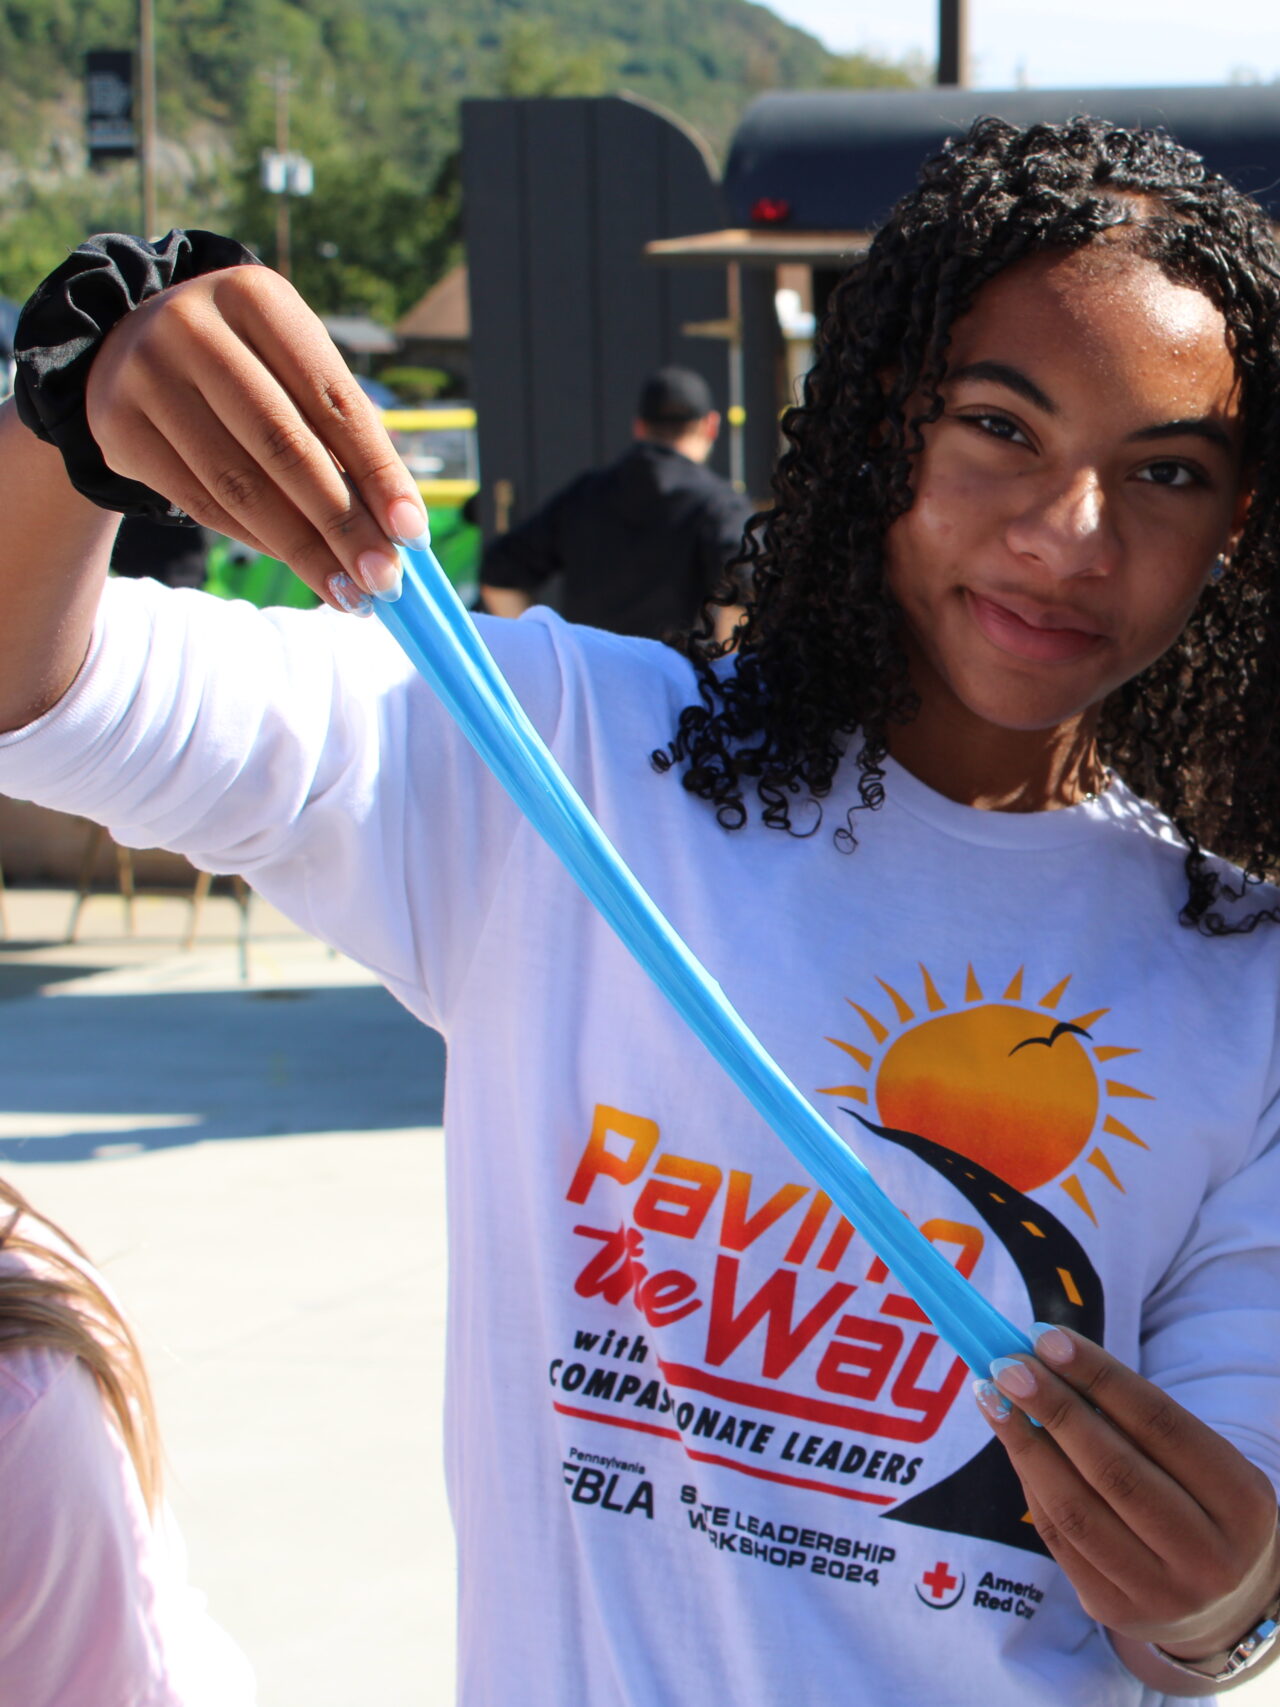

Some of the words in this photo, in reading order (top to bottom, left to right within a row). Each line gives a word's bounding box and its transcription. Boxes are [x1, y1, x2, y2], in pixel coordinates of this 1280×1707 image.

[573, 1329, 649, 1364] with
[703, 1253, 973, 1445] Way
[549, 1358, 775, 1456] COMPASONATE
[780, 1431, 924, 1486] LEADERS
[569, 1447, 646, 1475] Pennsylvania
[680, 1484, 730, 1527] STE
[734, 1511, 897, 1565] LEADERSHIP
[687, 1510, 807, 1579] WRKSHOP
[809, 1555, 881, 1588] 2024
[972, 1590, 1014, 1613] Red
